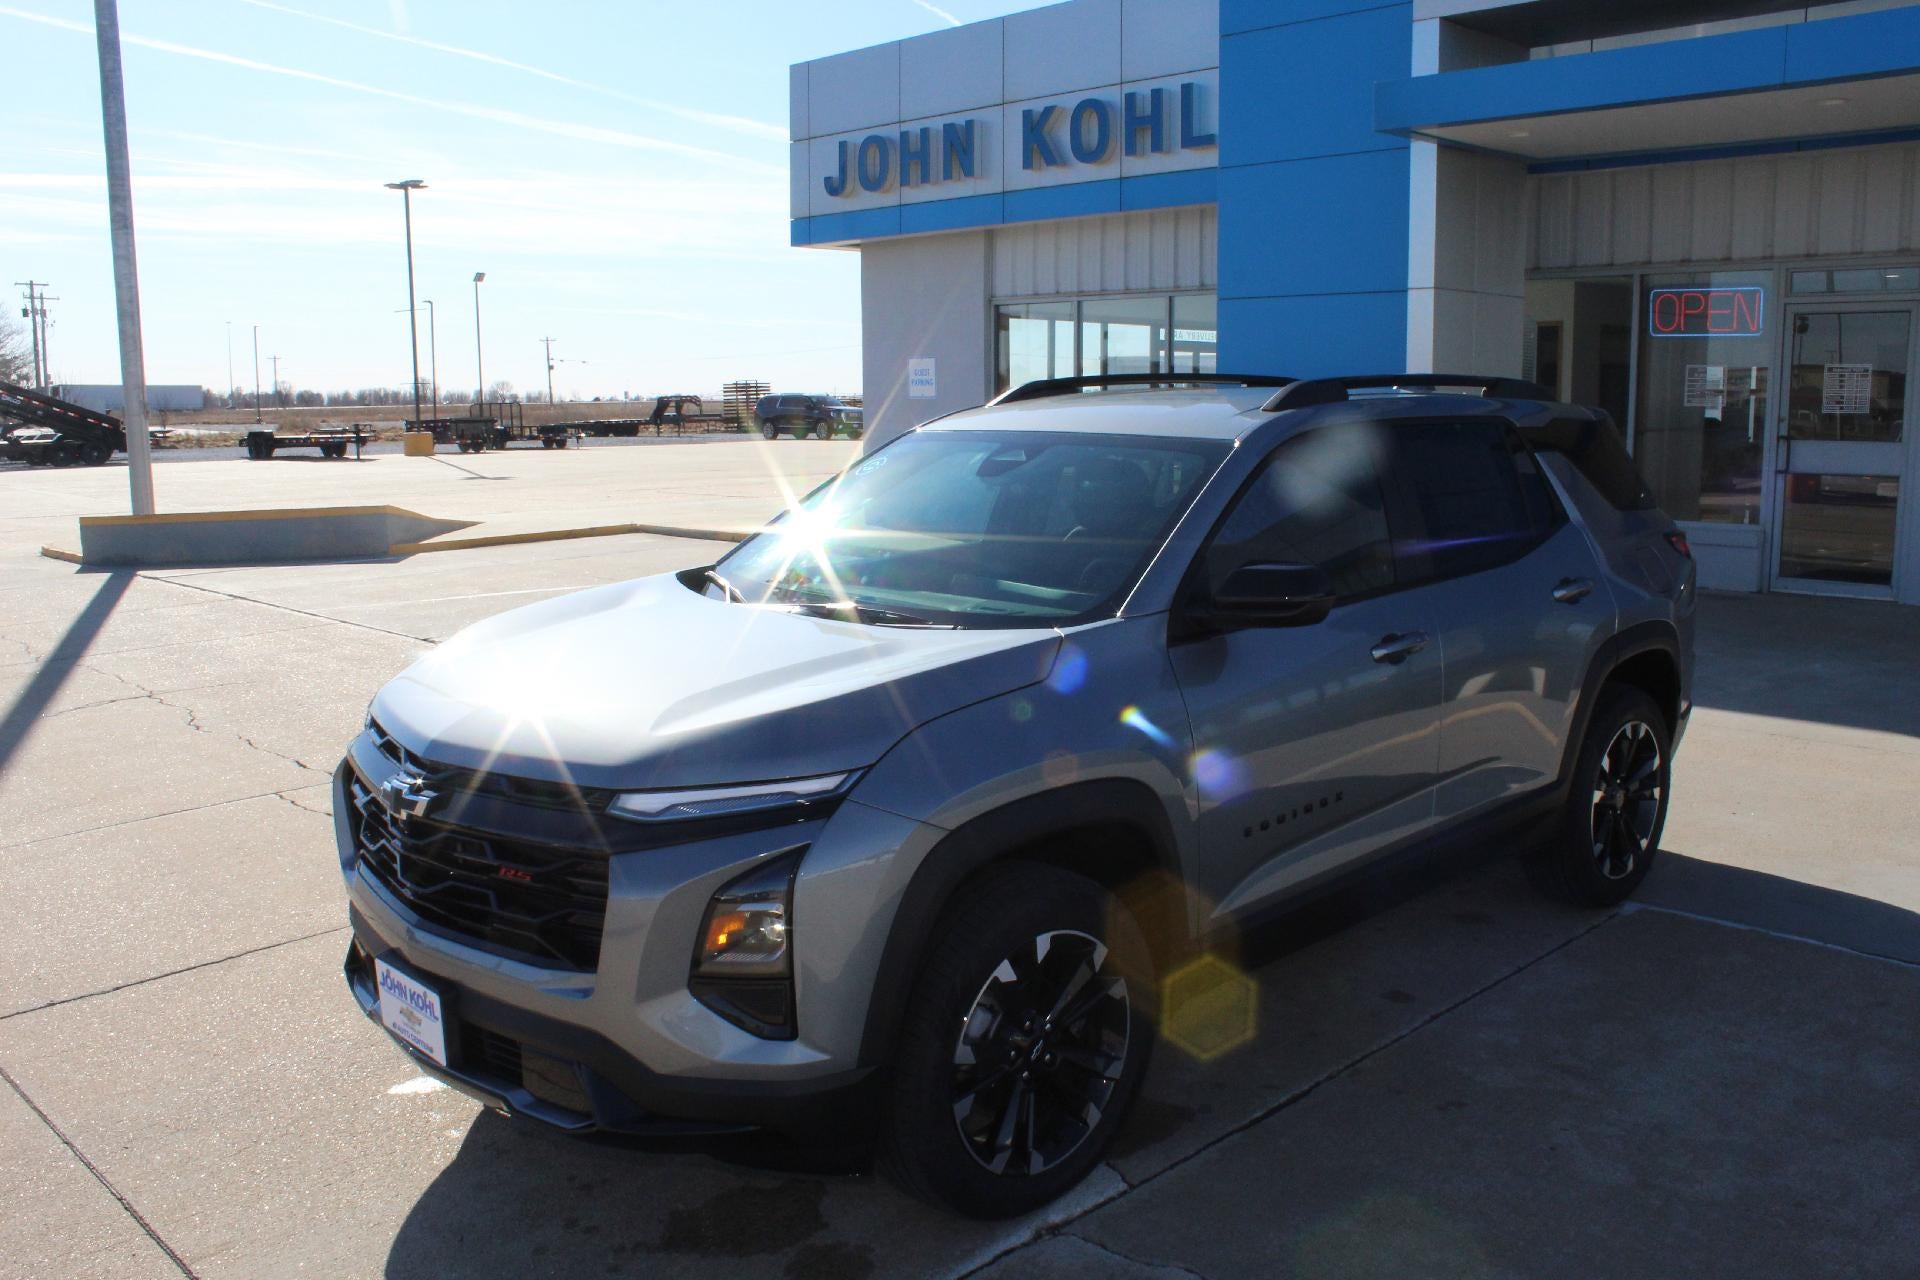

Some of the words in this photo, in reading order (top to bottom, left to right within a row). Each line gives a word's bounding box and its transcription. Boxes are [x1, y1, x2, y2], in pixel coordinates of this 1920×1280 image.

[823, 119, 978, 197] JOHN
[1021, 82, 1217, 171] KOHL
[1654, 291, 1760, 332] OPEN
[380, 971, 408, 1001] JOHN
[409, 988, 439, 1021] KOHL
